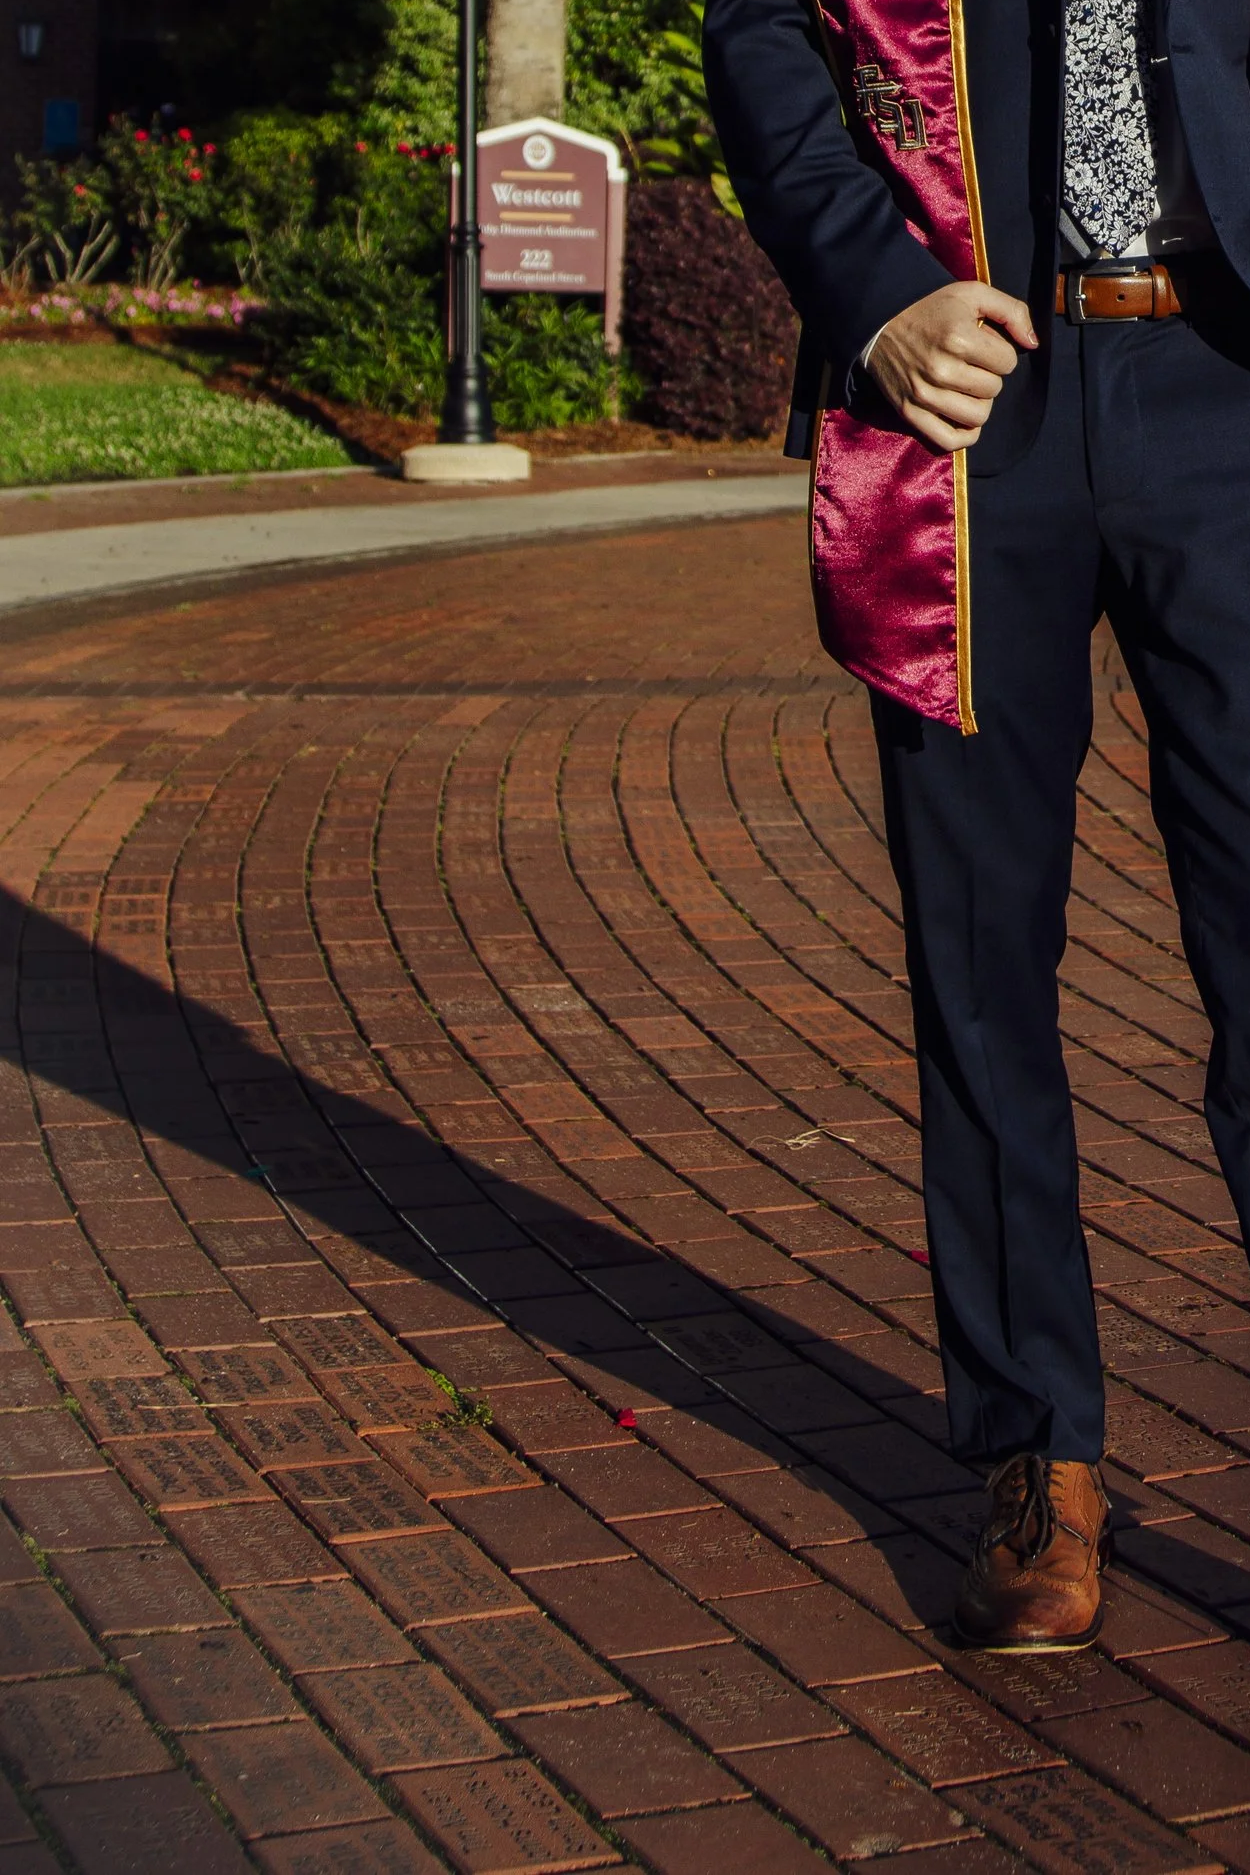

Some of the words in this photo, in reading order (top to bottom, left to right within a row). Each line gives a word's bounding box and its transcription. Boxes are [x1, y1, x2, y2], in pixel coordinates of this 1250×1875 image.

[854, 64, 929, 150] FSU
[491, 183, 582, 207] Westcott
[500, 223, 542, 237] Diamond
[544, 225, 598, 239] Auditorium
[519, 249, 553, 269] 222
[513, 272, 553, 285] Copeland
[555, 273, 585, 284] Street
